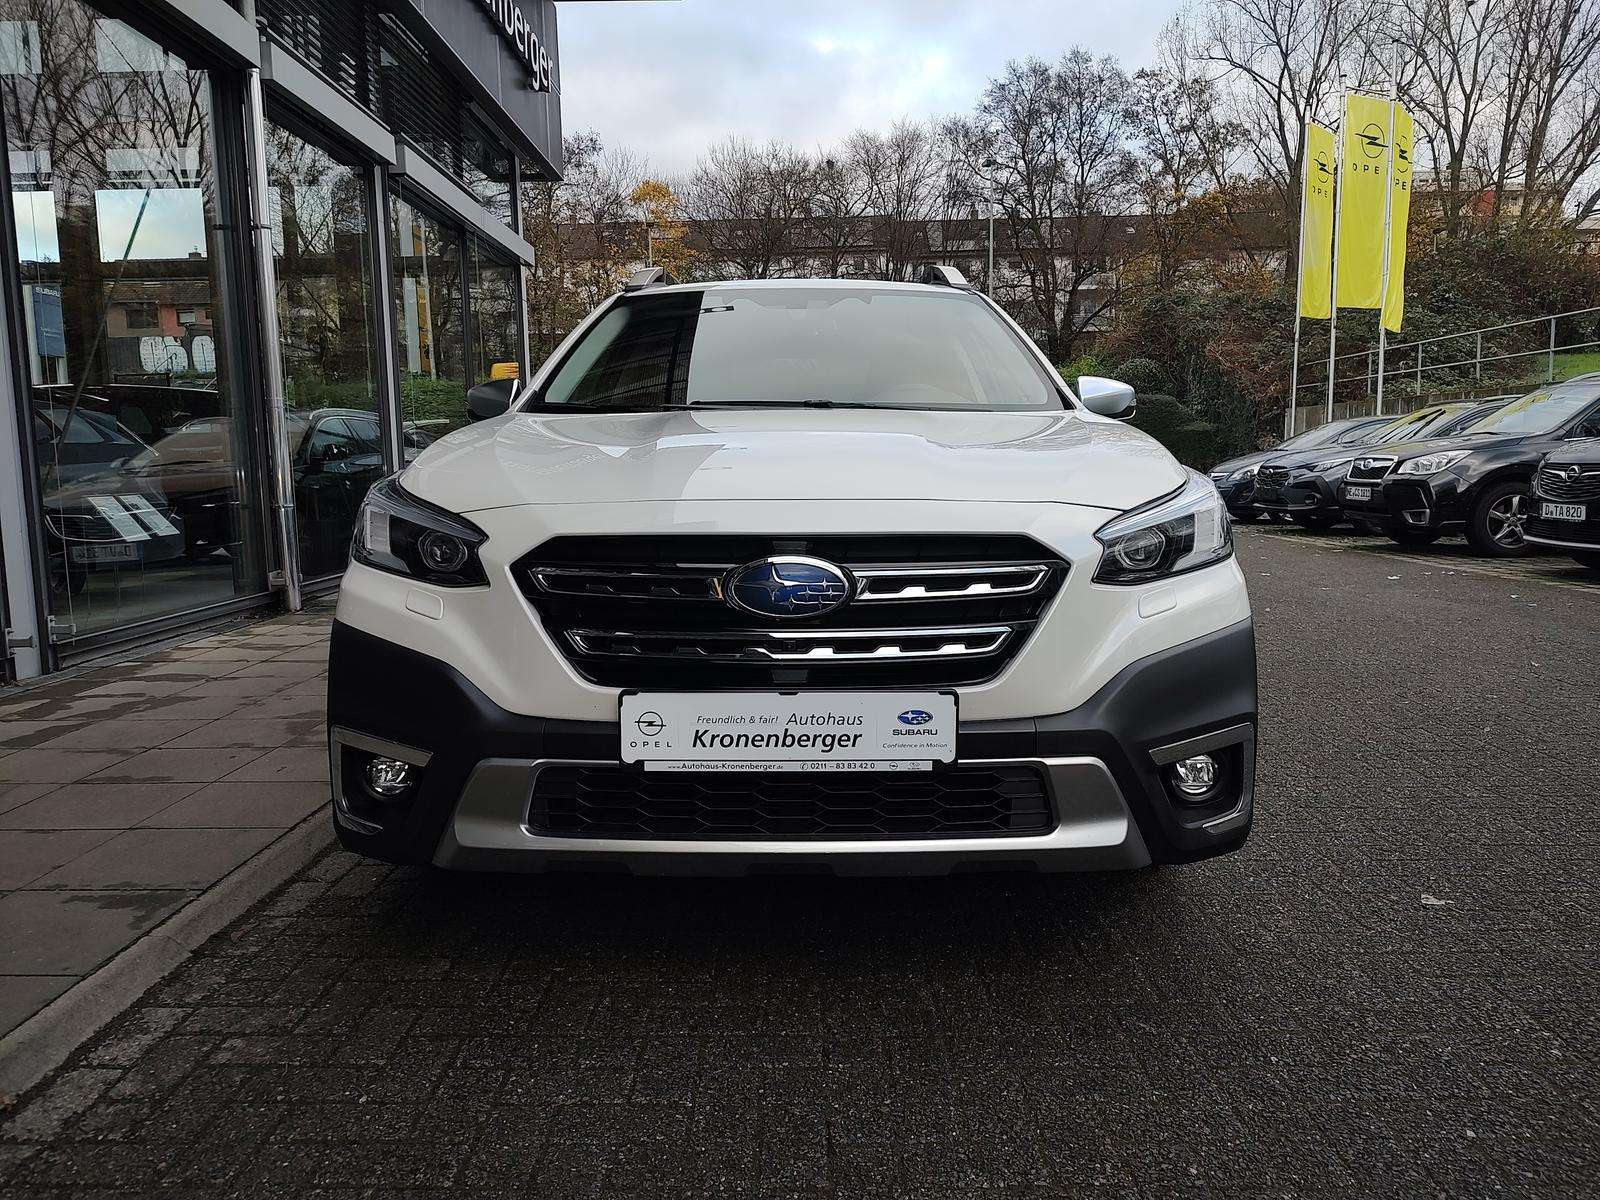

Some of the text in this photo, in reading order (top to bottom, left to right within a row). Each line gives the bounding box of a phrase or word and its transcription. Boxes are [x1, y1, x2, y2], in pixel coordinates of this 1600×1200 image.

[1554, 505, 1564, 517] TA
[1566, 506, 1582, 518] 820
[697, 712, 864, 726] Freundlich & fair! Autohaus
[892, 728, 938, 736] SUBARU
[692, 728, 863, 753] Kronenberger
[810, 762, 827, 770] 0211
[836, 762, 845, 770] 83
[847, 762, 856, 770] 83
[858, 762, 868, 770] 42
